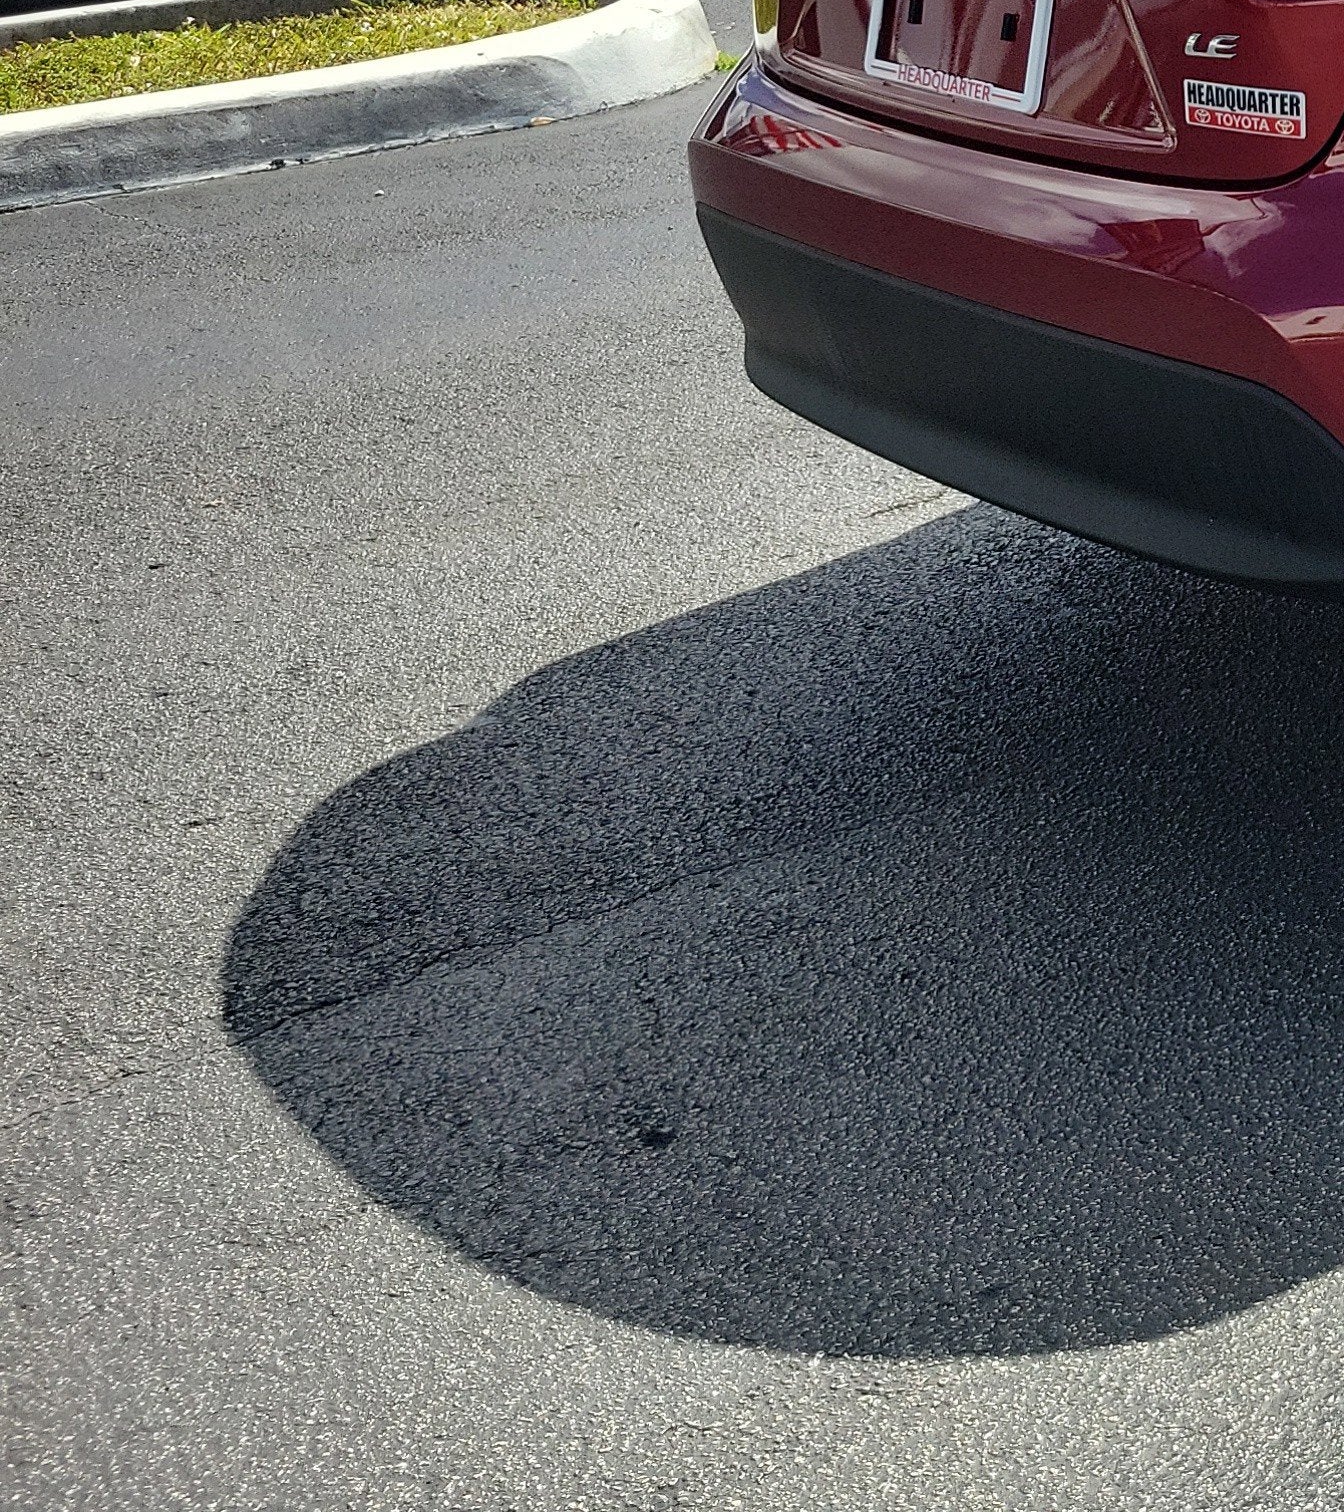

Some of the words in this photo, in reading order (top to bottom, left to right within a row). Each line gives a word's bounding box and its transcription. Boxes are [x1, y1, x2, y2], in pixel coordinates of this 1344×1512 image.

[1184, 33, 1240, 59] LE
[898, 63, 991, 102] HEADQUARTER
[1186, 81, 1301, 117] HEADQUARTER
[1215, 111, 1270, 132] TOYOTA
